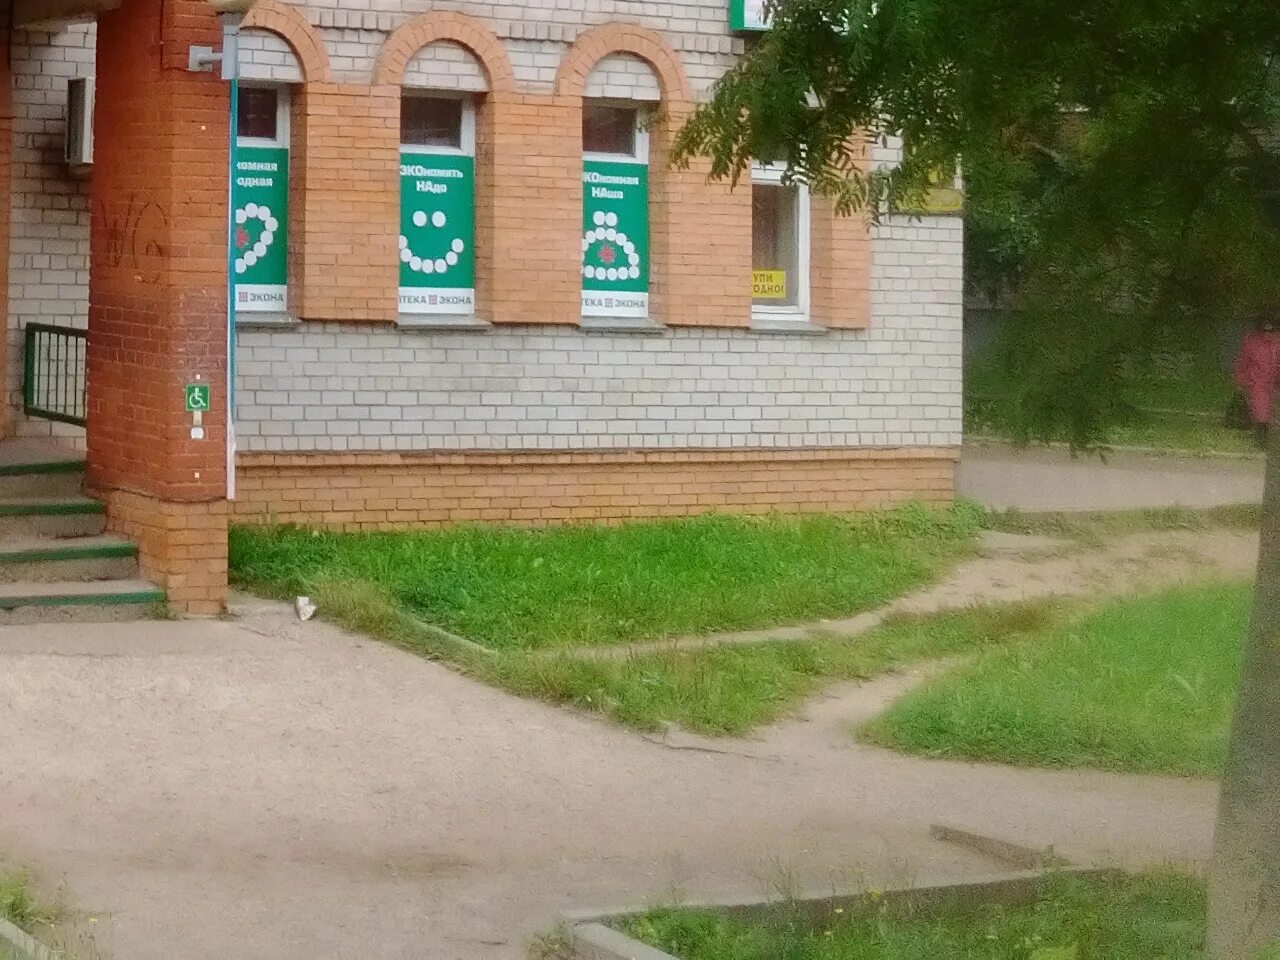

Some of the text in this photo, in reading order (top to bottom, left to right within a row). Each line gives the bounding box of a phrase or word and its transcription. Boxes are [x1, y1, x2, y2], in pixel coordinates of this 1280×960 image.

[752, 284, 784, 295] ОДНО!
[250, 292, 284, 301] ЭКОНА
[439, 295, 472, 305] ЭКОНА
[583, 298, 645, 308] ЕКА ЭКОНА
